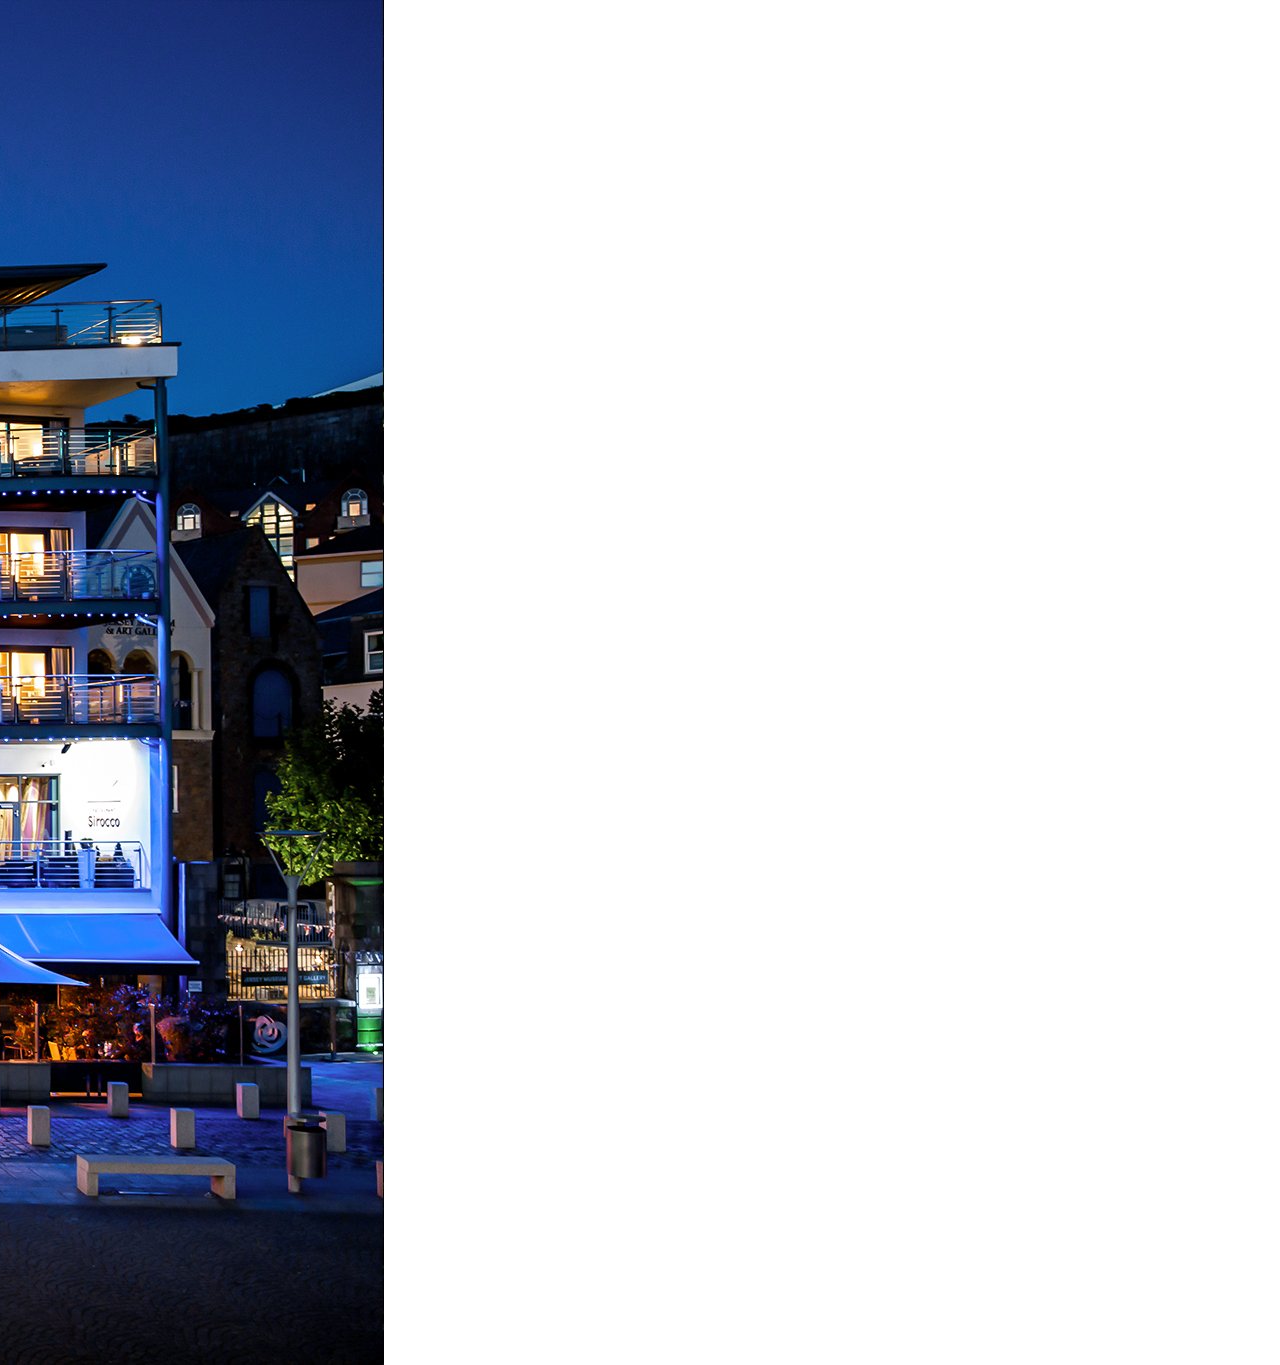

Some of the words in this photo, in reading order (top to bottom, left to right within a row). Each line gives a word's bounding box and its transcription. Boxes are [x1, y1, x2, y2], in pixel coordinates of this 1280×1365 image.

[106, 627, 114, 635] &
[116, 627, 132, 635] ART
[88, 816, 121, 828] Sirocco
